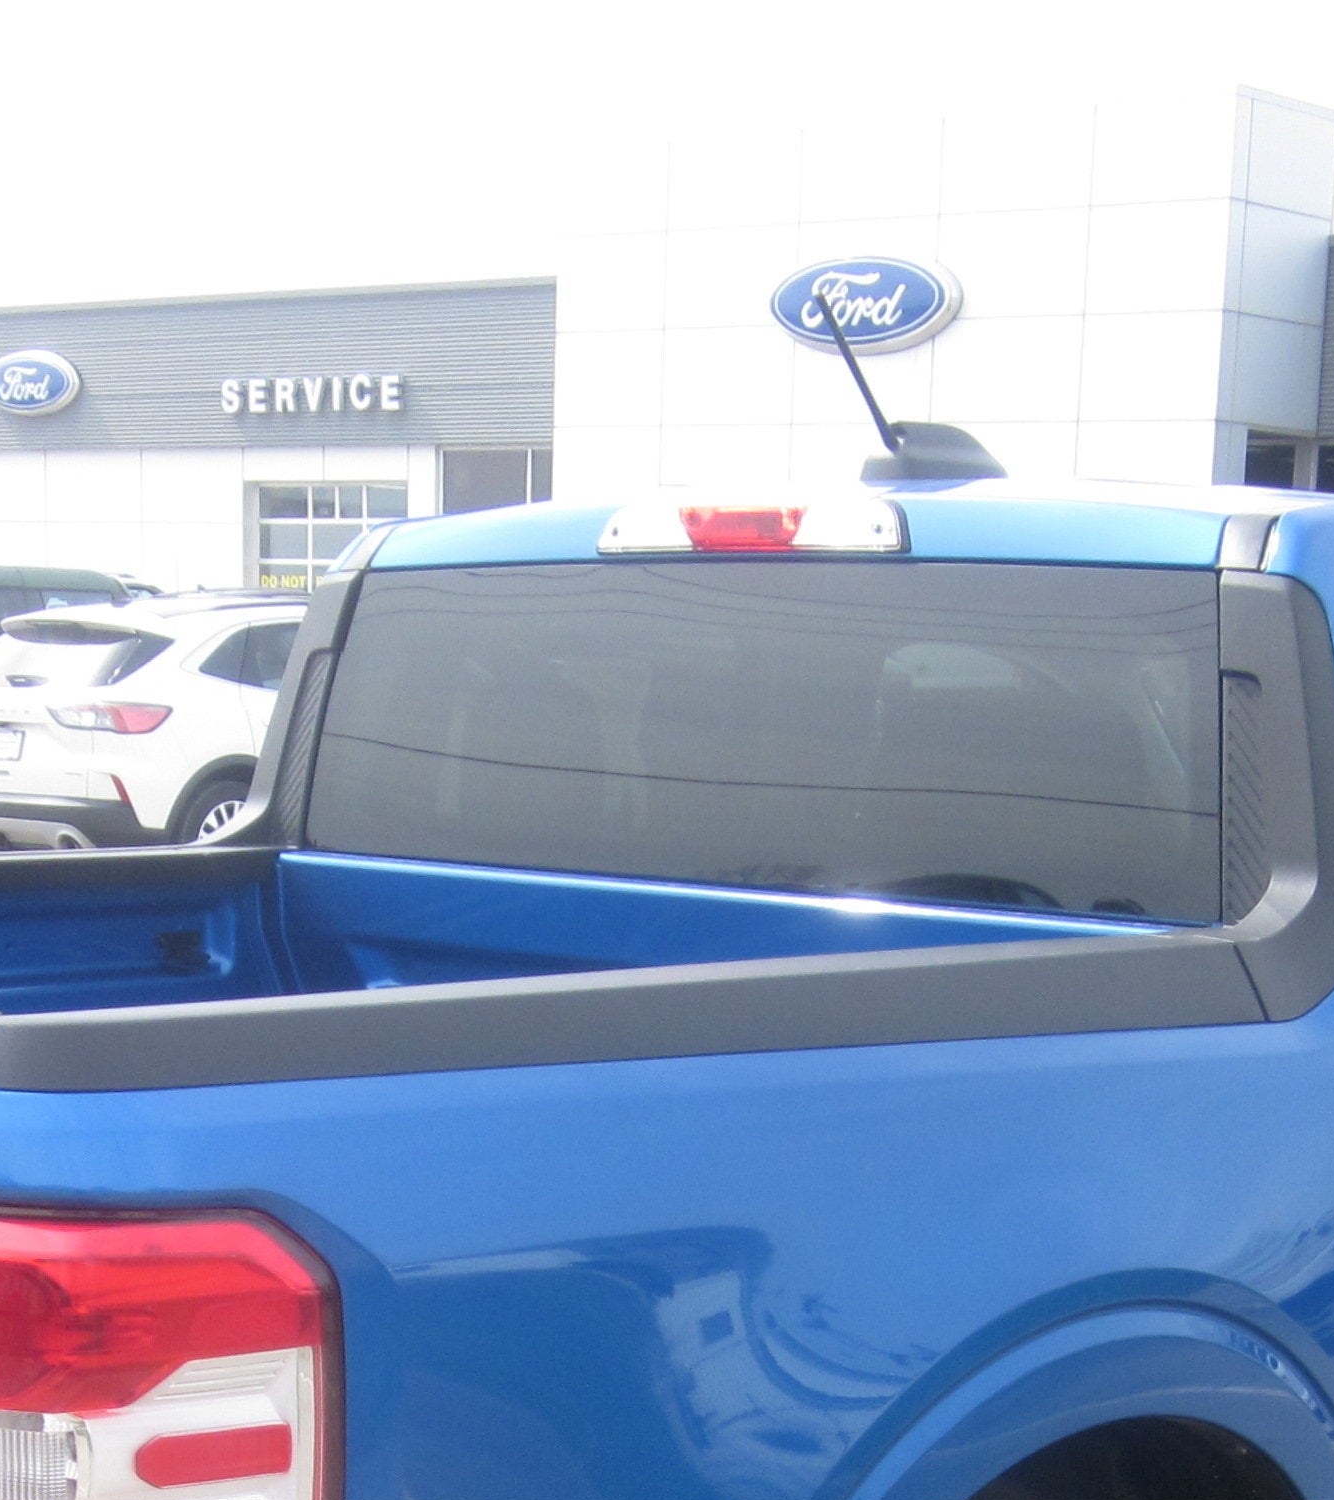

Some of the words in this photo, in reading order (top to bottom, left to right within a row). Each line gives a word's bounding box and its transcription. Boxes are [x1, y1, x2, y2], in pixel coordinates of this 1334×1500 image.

[801, 270, 907, 329] Ford
[220, 372, 403, 414] SERVICE
[260, 574, 278, 588] DO
[281, 574, 307, 588] NOT
